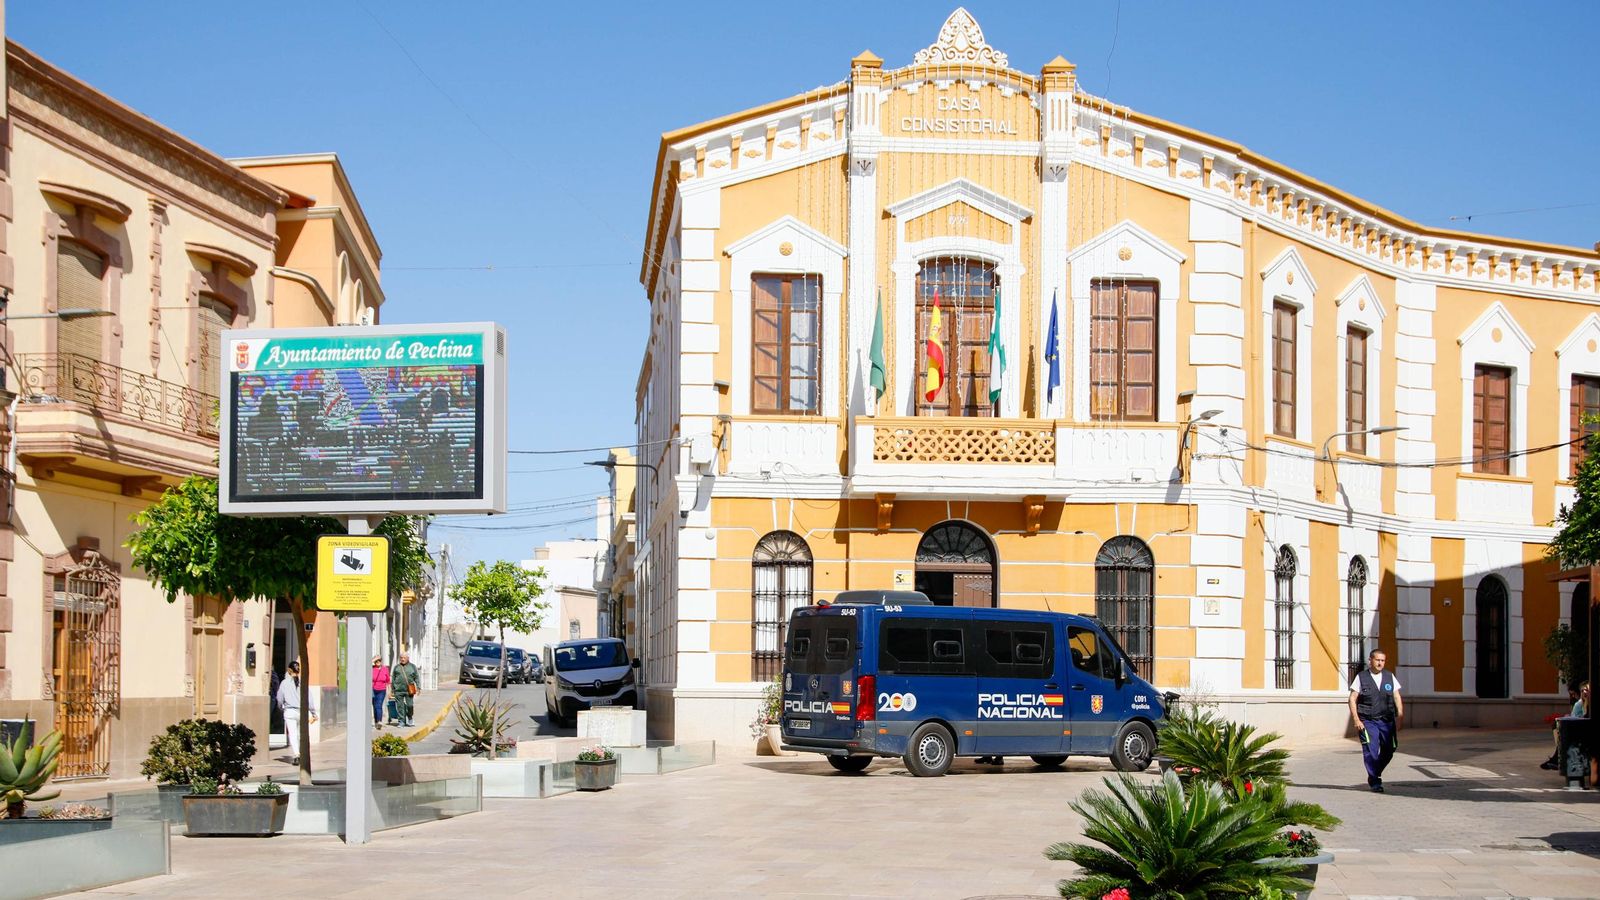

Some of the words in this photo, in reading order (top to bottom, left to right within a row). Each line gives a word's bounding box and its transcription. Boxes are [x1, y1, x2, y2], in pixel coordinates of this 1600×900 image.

[938, 97, 981, 111] CASA
[901, 117, 1017, 135] CONSISTORIAL
[264, 343, 382, 368] Ayuntamiento
[385, 341, 404, 360] de
[407, 339, 474, 360] Pechina
[978, 693, 1047, 706] POLICIA
[784, 700, 834, 714] POLICIA
[977, 706, 1063, 718] NACIONAL
